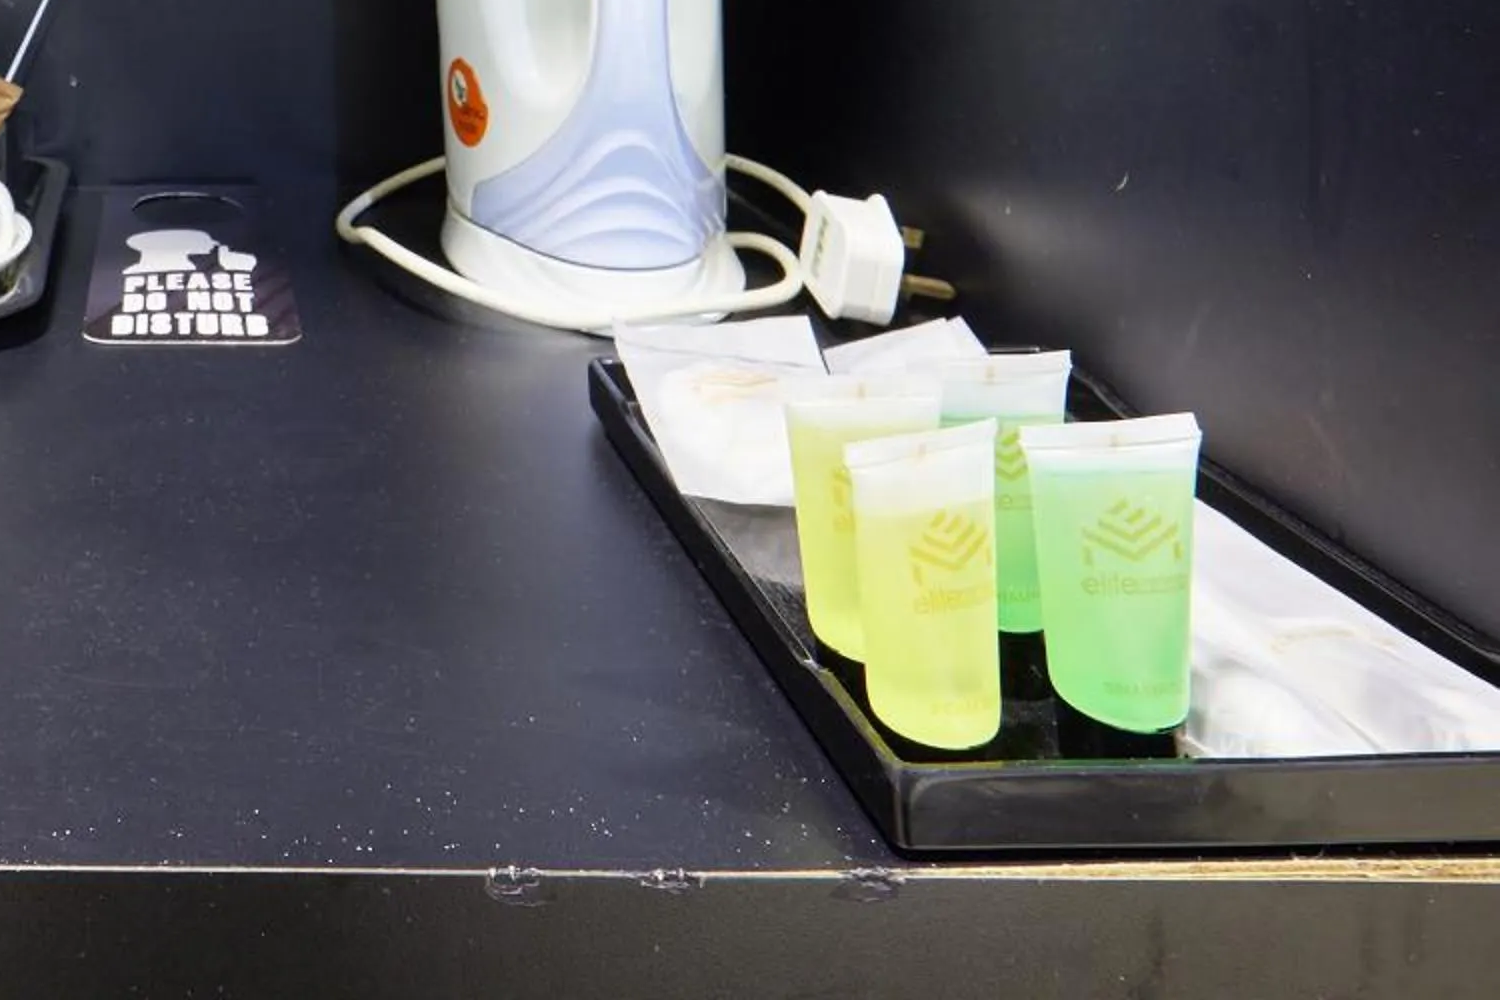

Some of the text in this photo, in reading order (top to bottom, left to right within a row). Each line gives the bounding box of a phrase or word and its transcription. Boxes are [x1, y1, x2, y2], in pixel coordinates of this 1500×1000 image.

[124, 273, 253, 293] PLEASE
[122, 292, 254, 313] DO NOT
[111, 313, 269, 336] DISTURB
